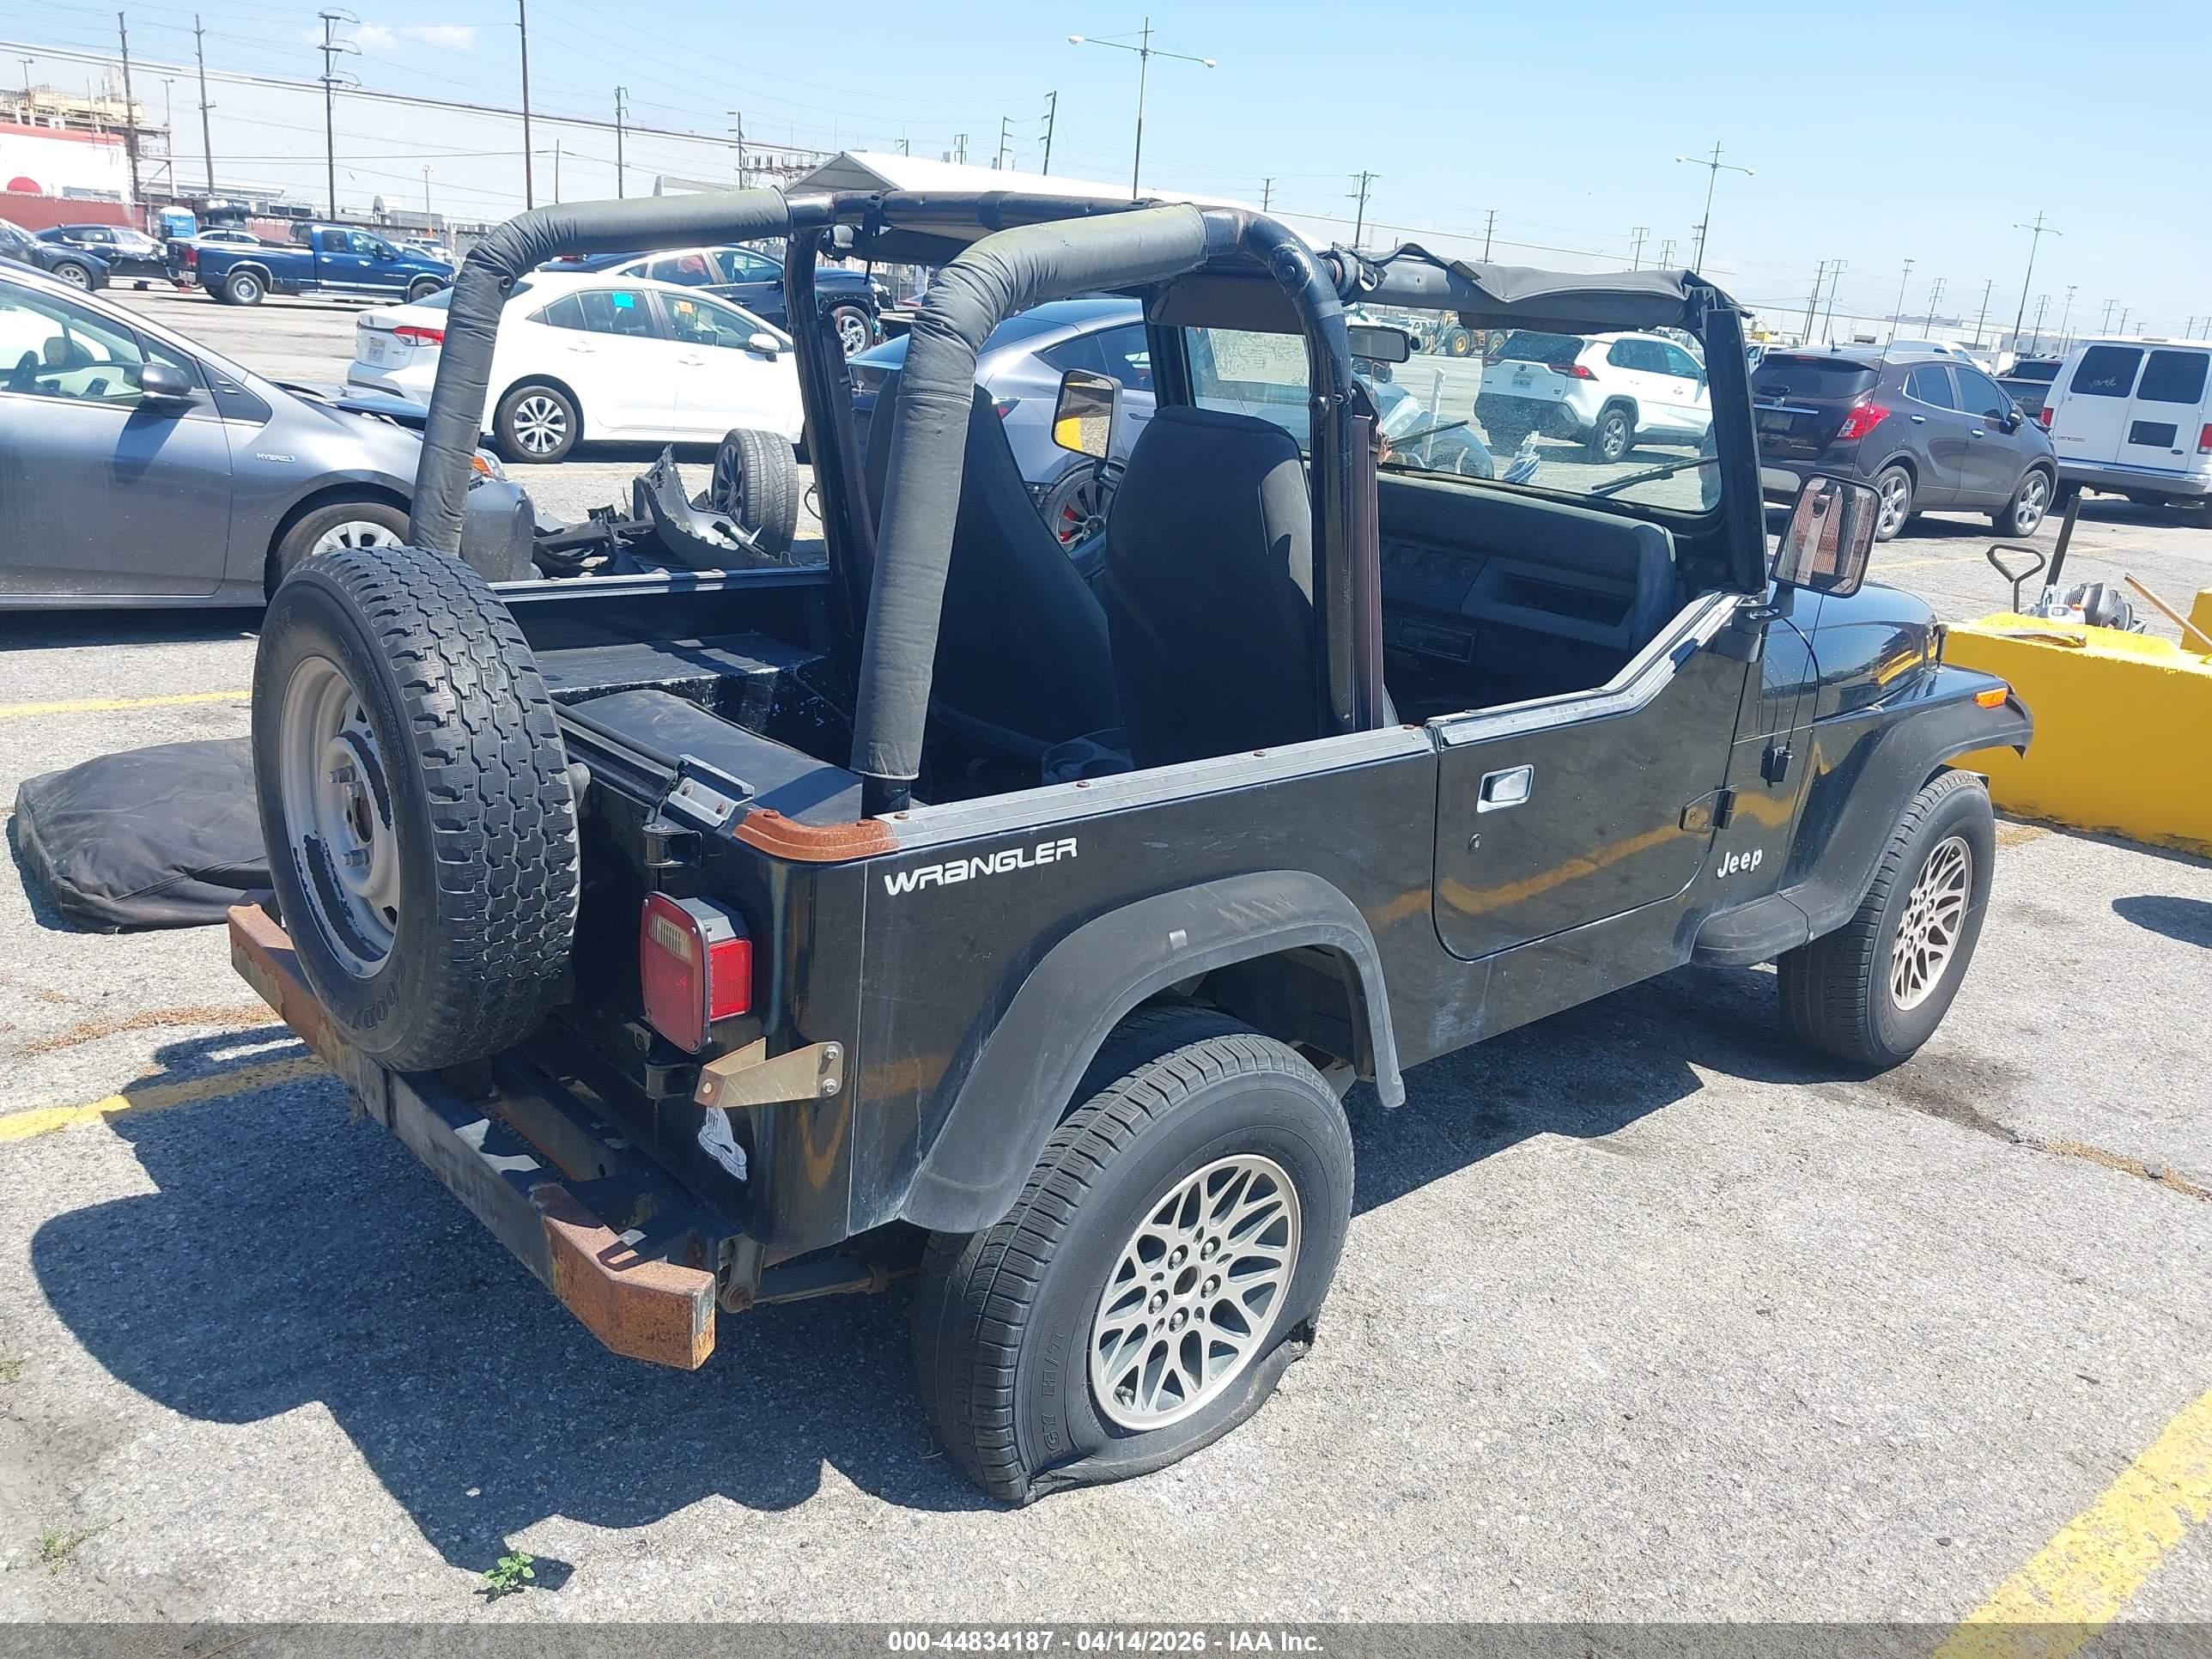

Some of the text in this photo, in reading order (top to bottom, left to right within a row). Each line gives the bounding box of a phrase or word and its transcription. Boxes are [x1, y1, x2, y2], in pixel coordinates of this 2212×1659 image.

[255, 453, 295, 464] HYBRID
[884, 837, 1078, 896] WRANGLER
[1717, 848, 1763, 878] Jeep
